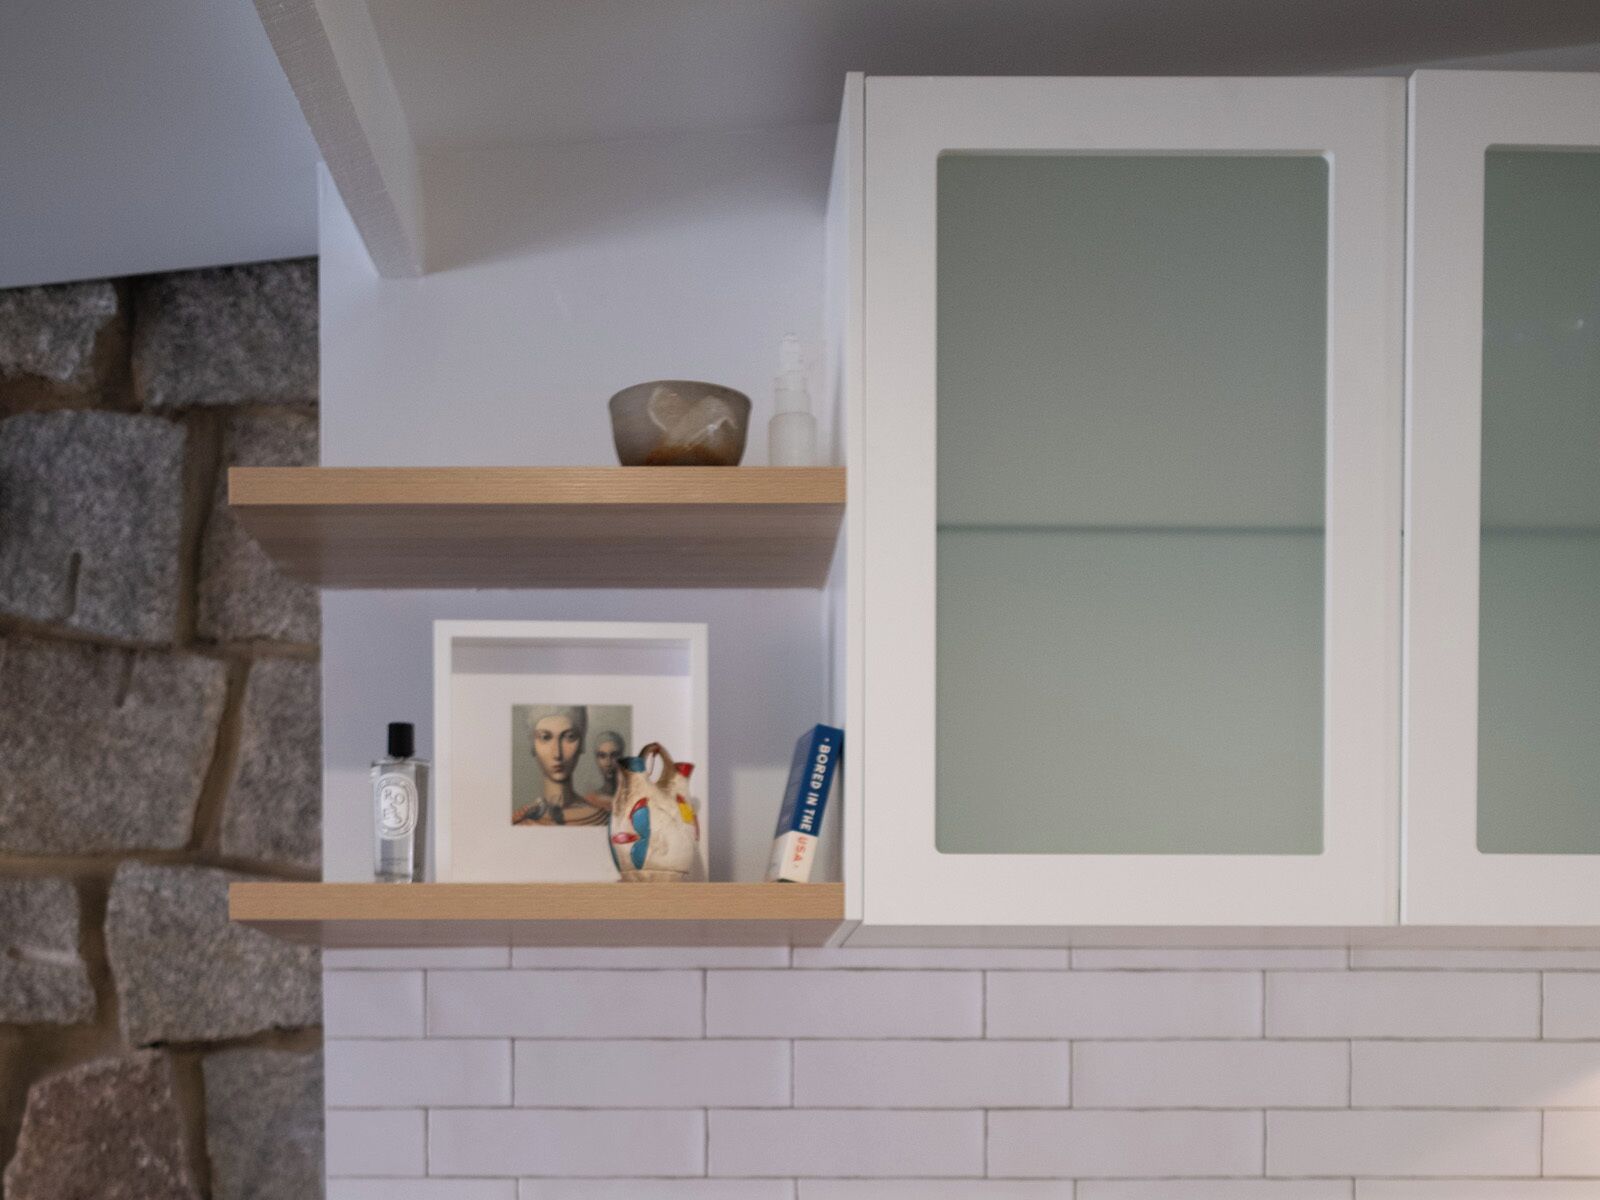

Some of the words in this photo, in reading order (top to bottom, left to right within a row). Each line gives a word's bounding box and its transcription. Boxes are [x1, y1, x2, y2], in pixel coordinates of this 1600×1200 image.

[810, 744, 831, 790] BORED
[805, 792, 820, 806] IN
[799, 809, 816, 832] THE
[793, 836, 808, 862] USA
